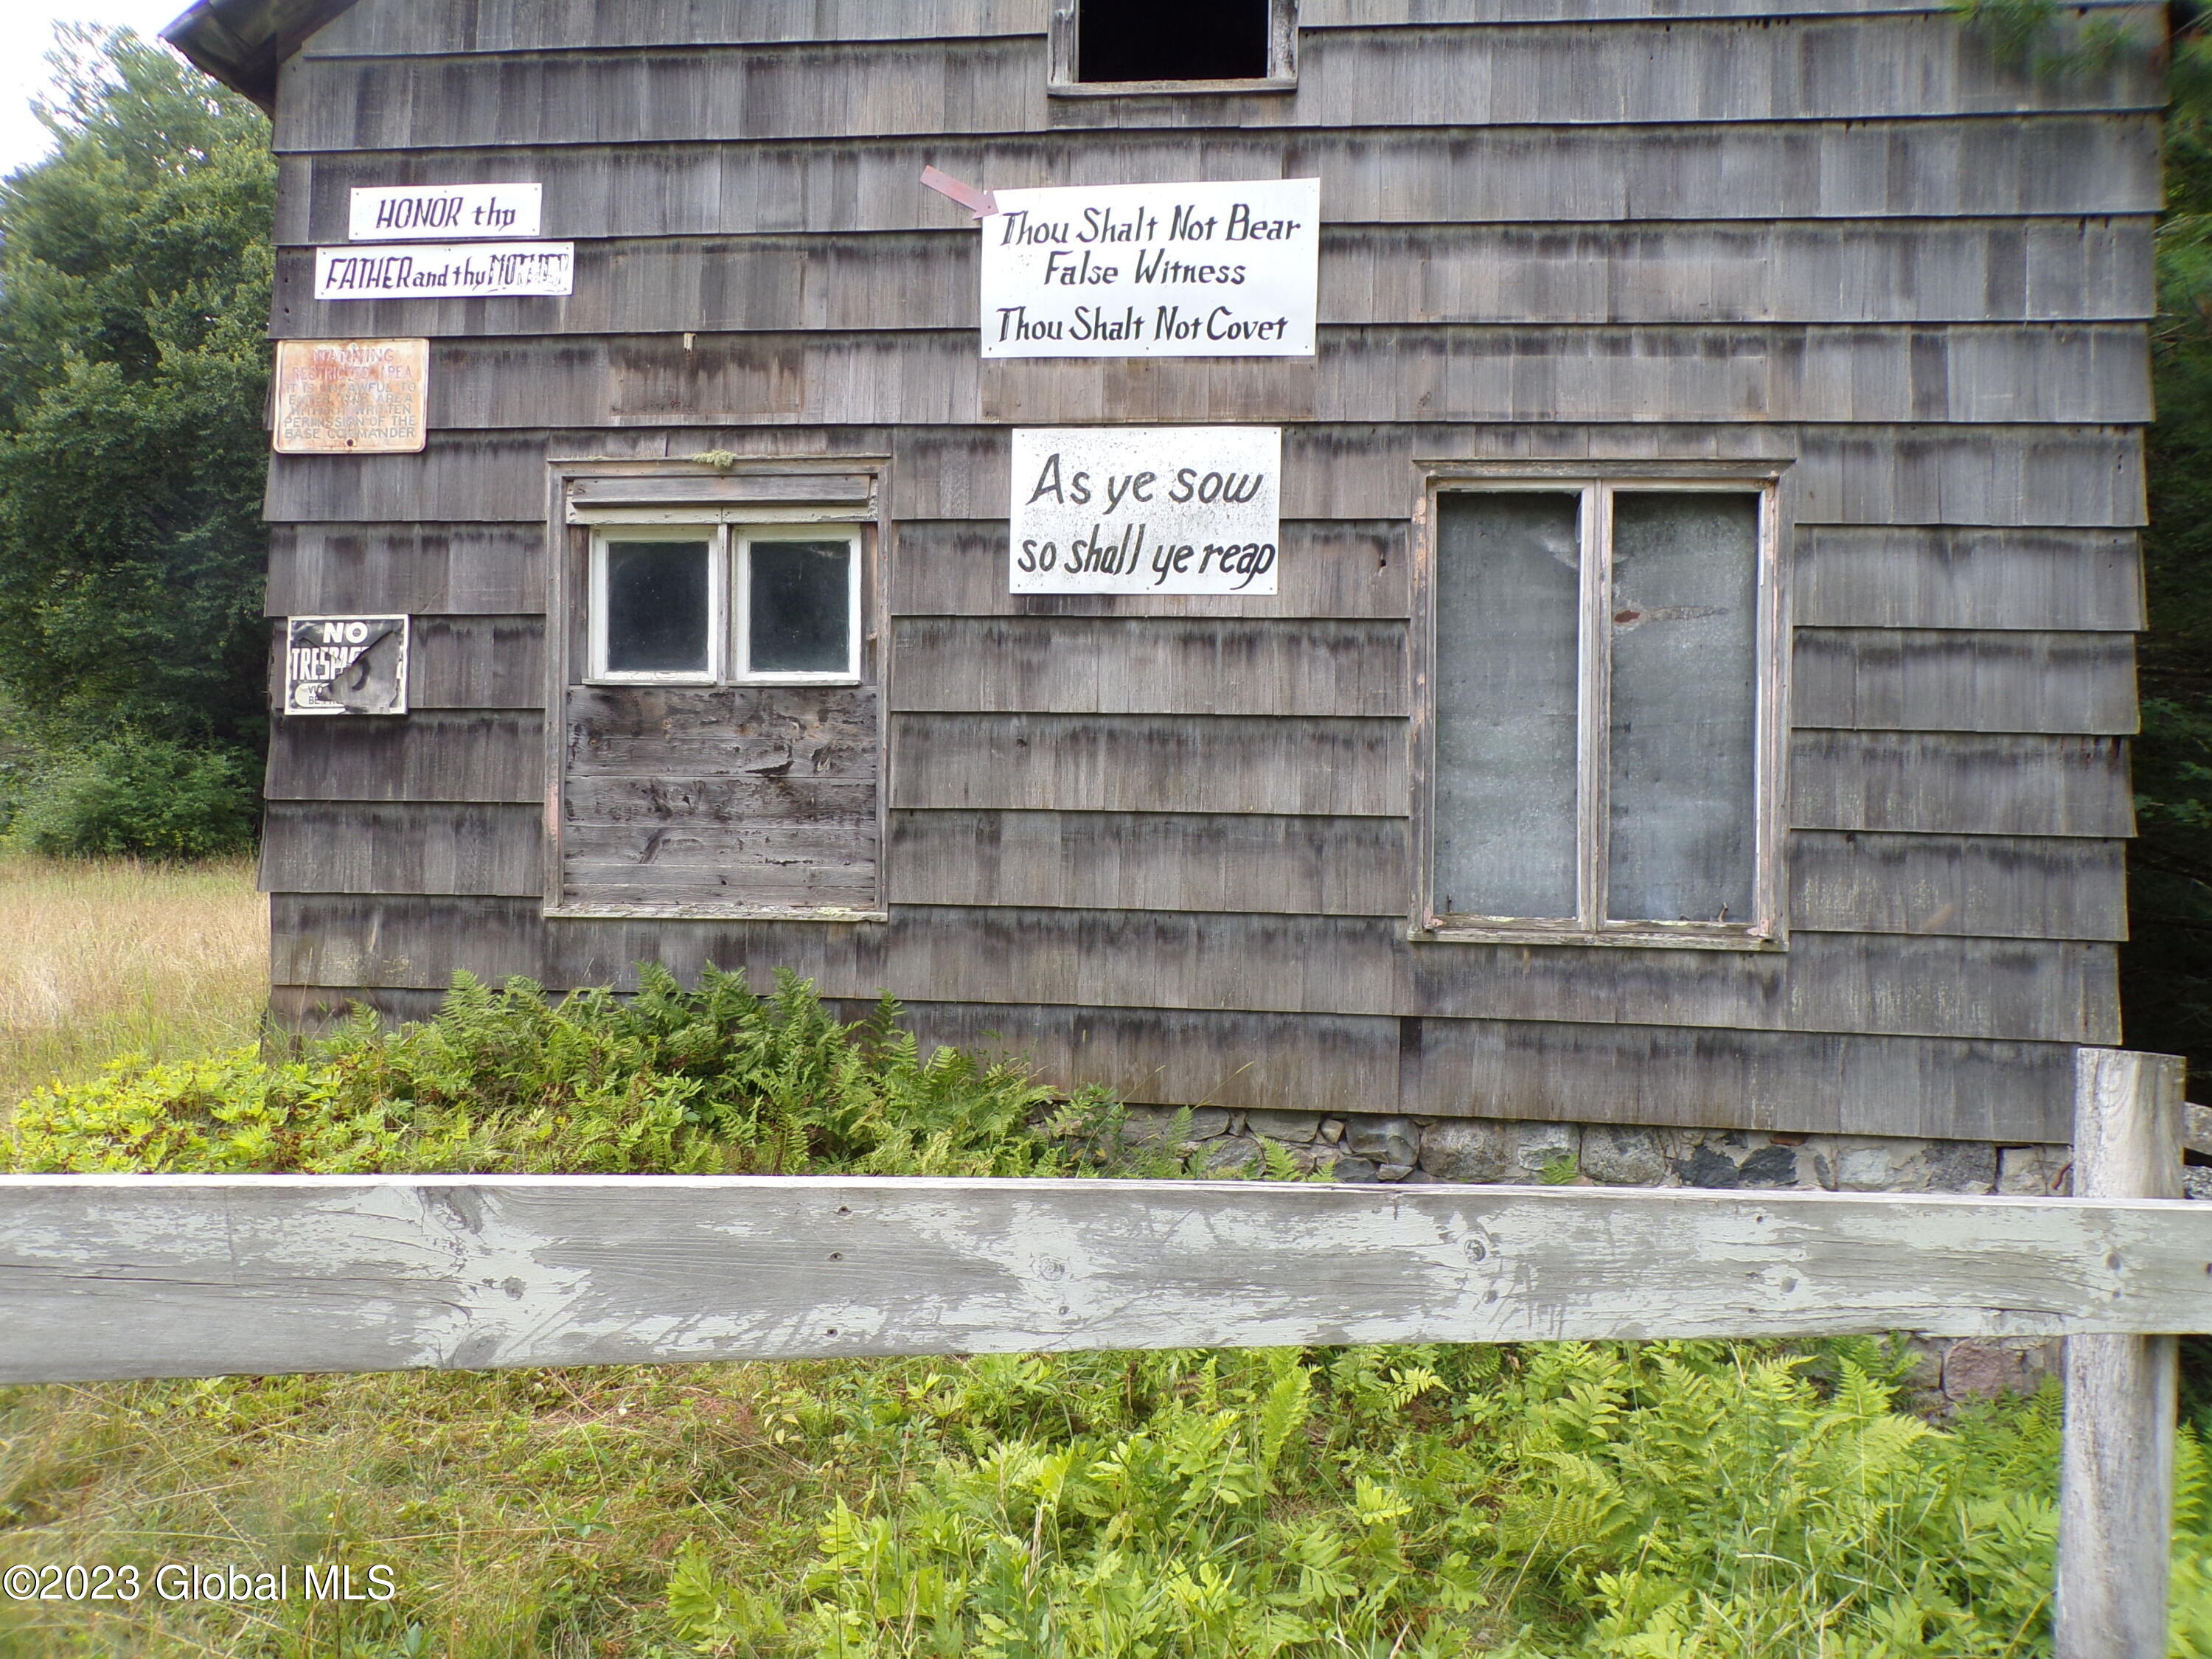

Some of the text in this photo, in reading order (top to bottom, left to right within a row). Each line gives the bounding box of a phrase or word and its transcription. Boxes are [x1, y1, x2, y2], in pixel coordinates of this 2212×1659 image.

[376, 196, 516, 232] HONOR thy
[1000, 203, 1301, 246] Thou Shalt Not Bear
[325, 256, 413, 290] FATHER
[411, 263, 449, 288] and
[451, 256, 488, 291] thy
[1043, 247, 1248, 286] False Witness
[995, 305, 1289, 342] Thou Shalt Not Covet
[377, 393, 414, 404] AREA
[400, 381, 417, 393] TO
[285, 428, 320, 439] BASE
[369, 416, 384, 427] OF
[392, 415, 417, 426] THE
[1025, 453, 1265, 515] As ye sow
[1017, 523, 1276, 591] so shall ye reap
[322, 622, 369, 644] NO
